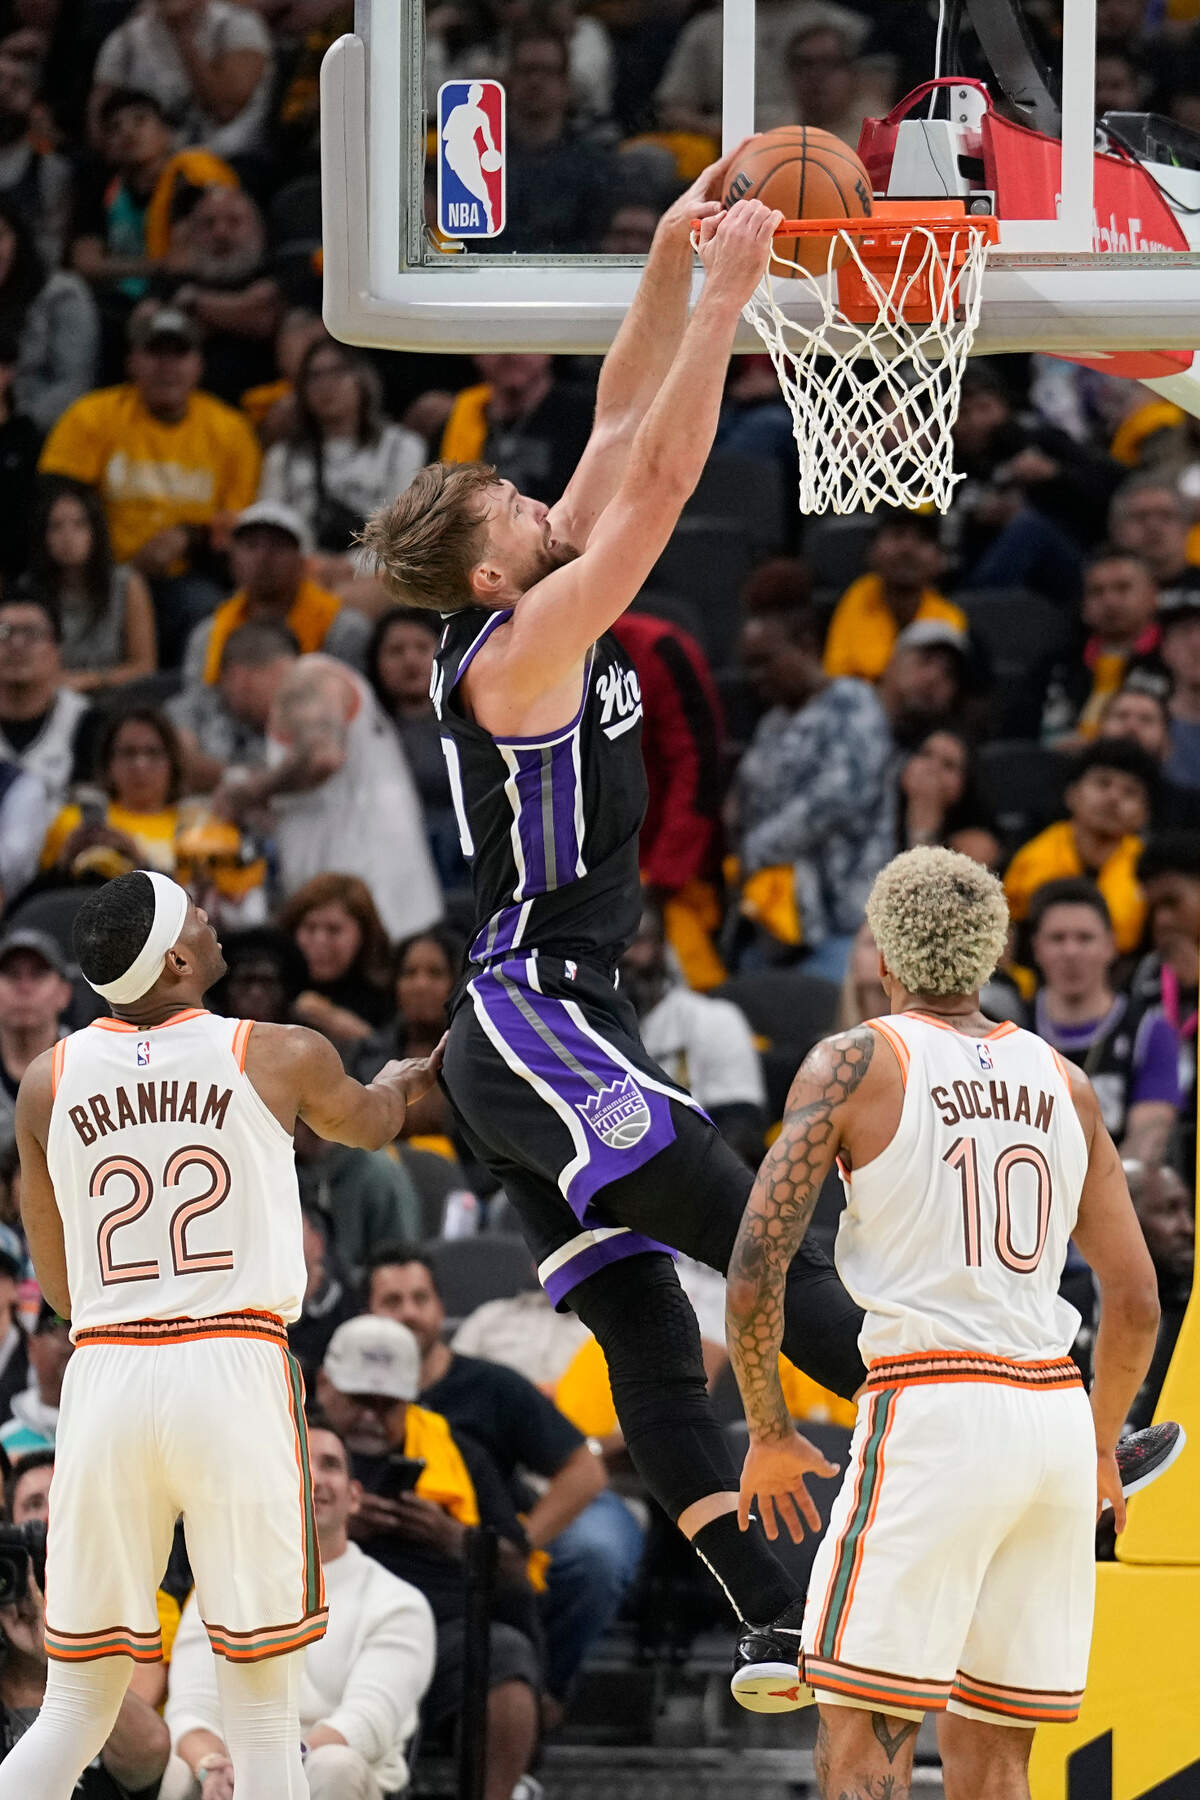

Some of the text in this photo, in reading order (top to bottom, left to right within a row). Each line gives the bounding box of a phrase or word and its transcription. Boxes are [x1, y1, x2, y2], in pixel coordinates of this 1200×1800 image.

[448, 202, 480, 228] NBA
[596, 661, 642, 725] Kin
[68, 1080, 233, 1147] BRANHAM
[594, 1097, 646, 1137] KINGS
[931, 1079, 1055, 1134] SOCHAN
[89, 1144, 234, 1287] 22
[942, 1137, 1053, 1274] 10
